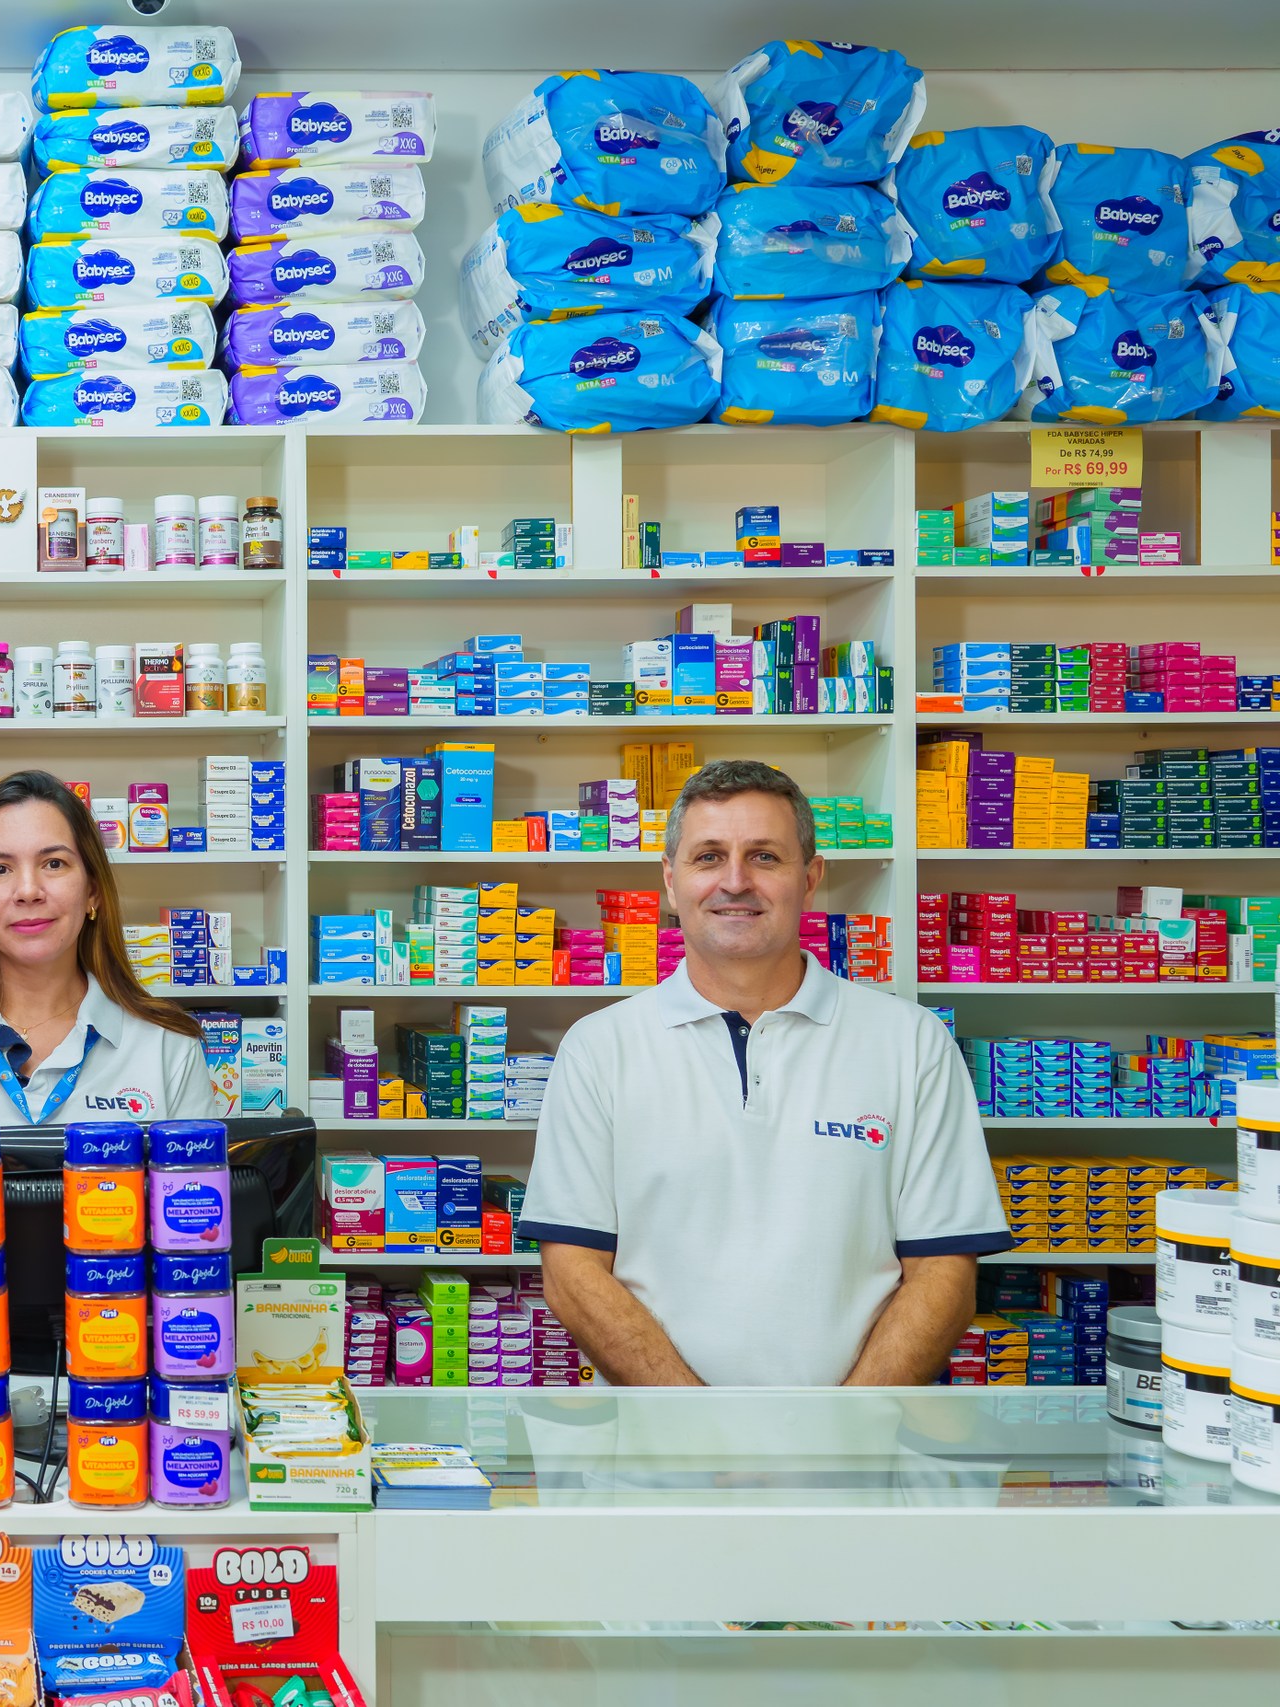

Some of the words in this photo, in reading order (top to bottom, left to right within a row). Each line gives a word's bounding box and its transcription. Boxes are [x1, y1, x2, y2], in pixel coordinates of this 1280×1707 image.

[90, 50, 145, 65] Babysec
[290, 117, 347, 134] Babysec
[398, 137, 415, 149] XXG
[620, 155, 637, 165] SEC
[83, 191, 139, 207] Babysec
[947, 189, 1006, 208] Babysec
[1100, 206, 1158, 225] Babysec
[971, 217, 986, 227] SEC
[275, 264, 331, 280] Babysec
[68, 331, 122, 347] Babysec
[279, 390, 336, 405] Babysec
[1046, 430, 1061, 438] FDA
[1062, 430, 1096, 438] BABYSEC
[1101, 430, 1122, 438] HIPER
[1066, 437, 1104, 445] VARIADAS
[1059, 449, 1071, 458] De
[1073, 448, 1086, 458] R$
[1088, 448, 1113, 459] 74,99
[1044, 467, 1060, 476] Por
[1063, 462, 1081, 477] R$
[1085, 461, 1127, 477] 69,99
[445, 767, 493, 777] Cetoconazol
[402, 767, 415, 831] Cetoconazol
[988, 895, 1010, 904] Ibupril
[951, 946, 973, 955] Ibupril
[201, 1018, 238, 1031] Apevinat
[246, 1042, 283, 1054] Apevitin
[269, 1052, 283, 1063] BC
[86, 1095, 130, 1110] LEVE
[814, 1120, 867, 1141] LEVE
[334, 1188, 376, 1196] desloratadina
[167, 1208, 219, 1217] MELATONINA
[288, 1252, 312, 1264] OURO
[256, 1303, 327, 1313] BANANINHA
[165, 1334, 215, 1342] MELATONINA
[177, 1408, 191, 1418] R$
[194, 1409, 220, 1420] 59,99
[290, 1468, 355, 1478] BANANINHA
[60, 1535, 154, 1567] BOLD
[216, 1550, 309, 1585] BOLD
[242, 1621, 255, 1630] R$
[258, 1618, 284, 1628] 10,00
